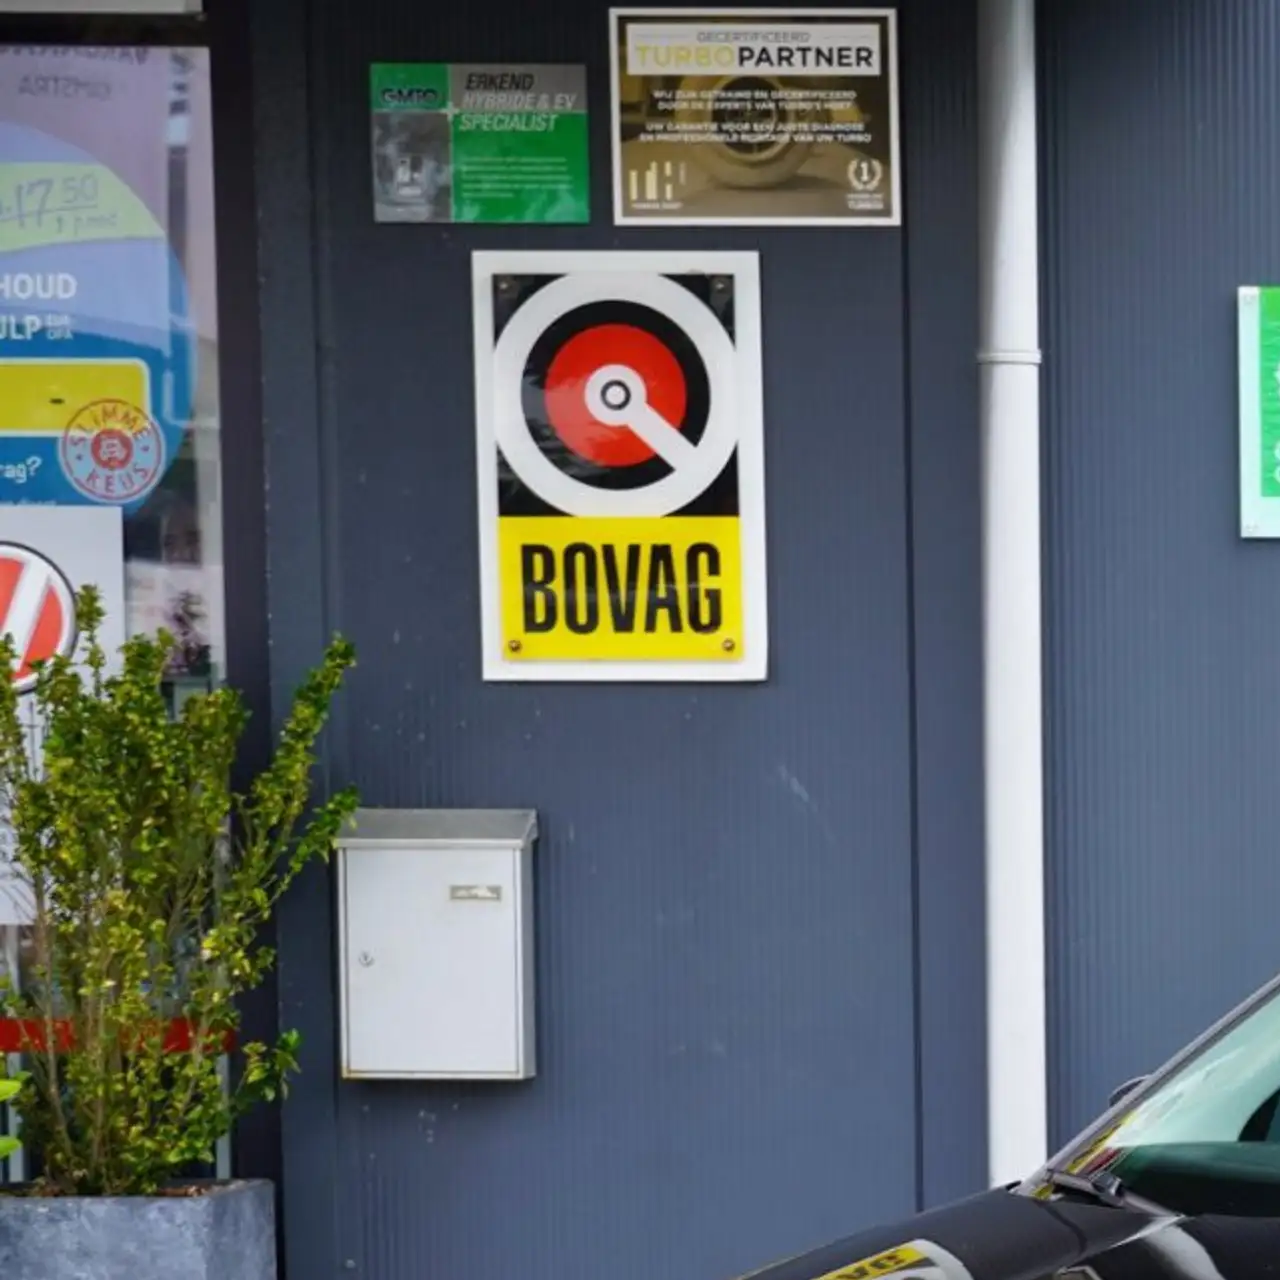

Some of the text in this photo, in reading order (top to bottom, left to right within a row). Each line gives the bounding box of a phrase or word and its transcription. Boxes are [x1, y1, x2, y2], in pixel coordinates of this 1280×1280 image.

[697, 31, 811, 43] GECERTIFICEERD
[465, 72, 534, 91] ERKEND
[754, 89, 768, 99] EN
[770, 89, 857, 100] GECERTIFICEERD
[460, 92, 577, 110] HYBRIDE & EV
[755, 100, 776, 110] VAN
[459, 113, 559, 132] SPECIALIST
[721, 122, 751, 132] VOOR
[793, 132, 814, 142] VAN
[837, 132, 872, 143] TURBO
[521, 542, 722, 635] BOVAG
